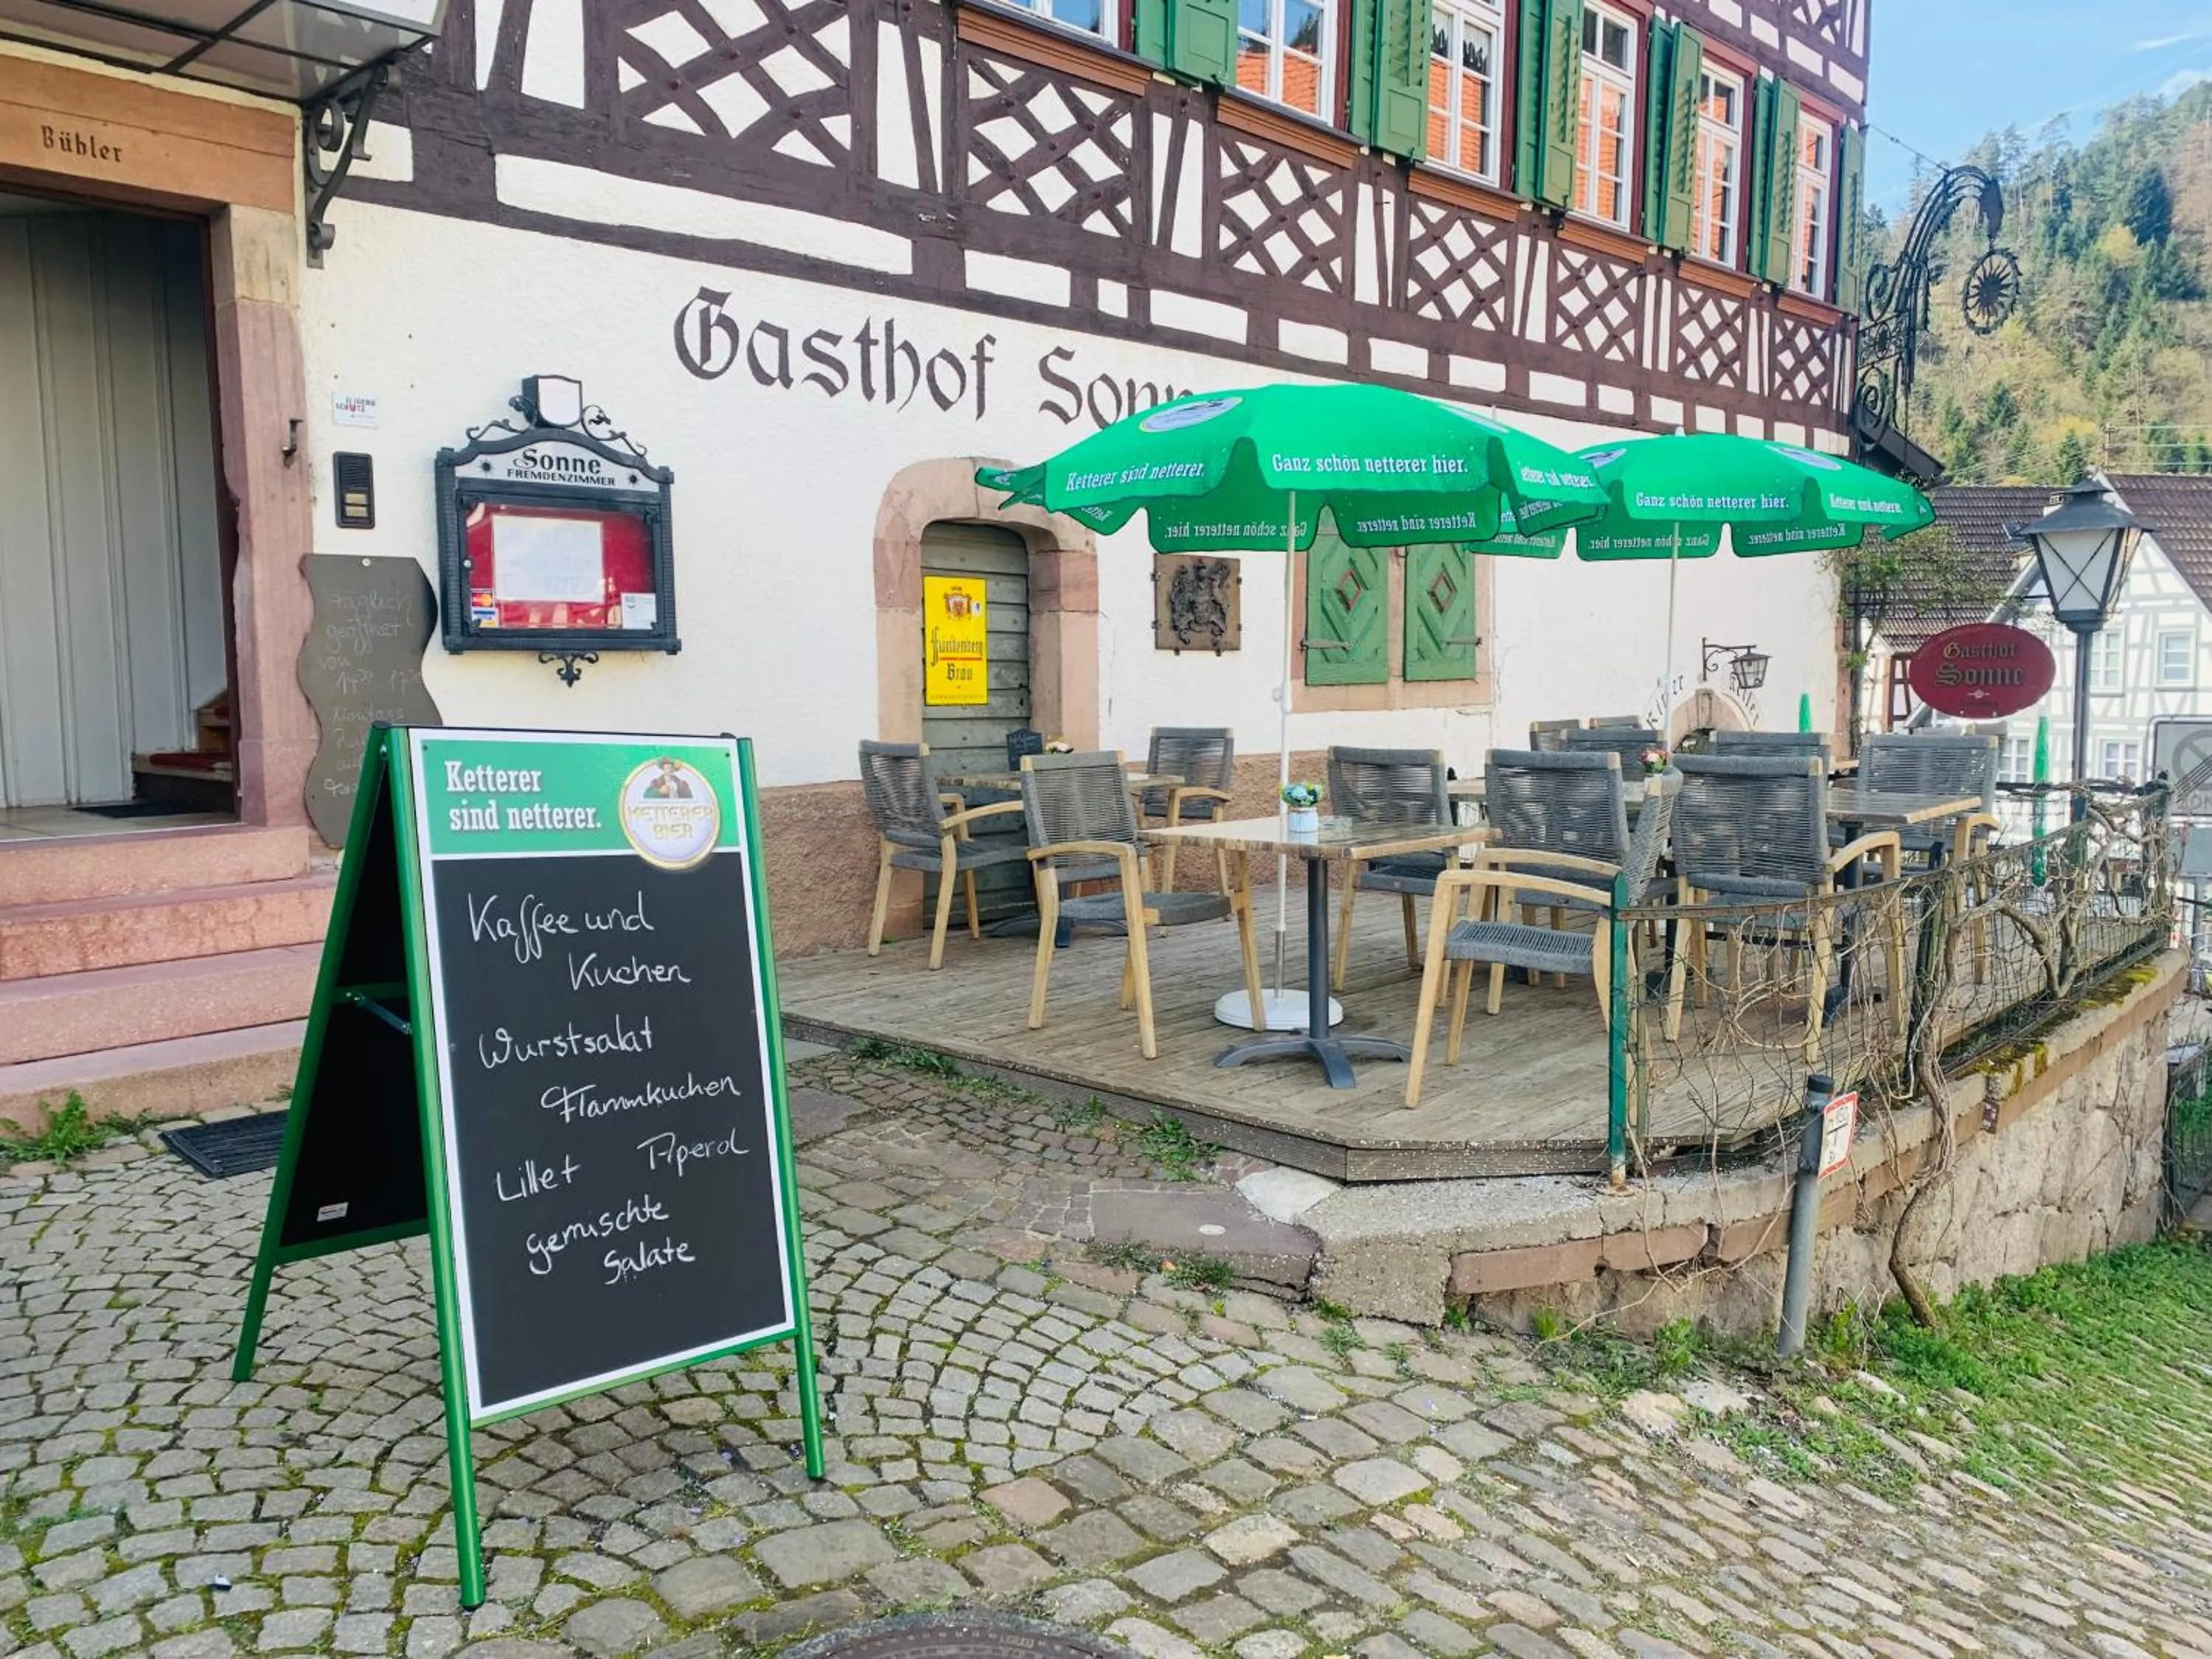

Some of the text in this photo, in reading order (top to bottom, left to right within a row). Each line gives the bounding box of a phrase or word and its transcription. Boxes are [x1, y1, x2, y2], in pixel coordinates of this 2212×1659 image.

[41, 124, 122, 163] Bühler
[674, 285, 997, 422] Gasthof
[507, 468, 616, 487] FREMDENZIMMER
[513, 448, 602, 475] Sonne
[1065, 462, 1205, 492] Ketterer sind netterer.
[1273, 453, 1469, 473] Ganz schön netterer hier.
[1636, 491, 1790, 509] Ganz schön netterer hier.
[1943, 642, 2018, 659] Gasthof
[1935, 663, 2024, 687] Sonne
[444, 760, 543, 793] Ketterer
[448, 798, 602, 831] sind netterer.
[652, 823, 694, 839] BIER
[468, 890, 655, 964] Kaffee und
[568, 952, 692, 992] Kuchen
[479, 1014, 653, 1069] Wurstsalat
[540, 1072, 741, 1124] Flammkuchen
[495, 1127, 751, 1202] Lillet Aperol
[603, 1237, 696, 1286] Salate
